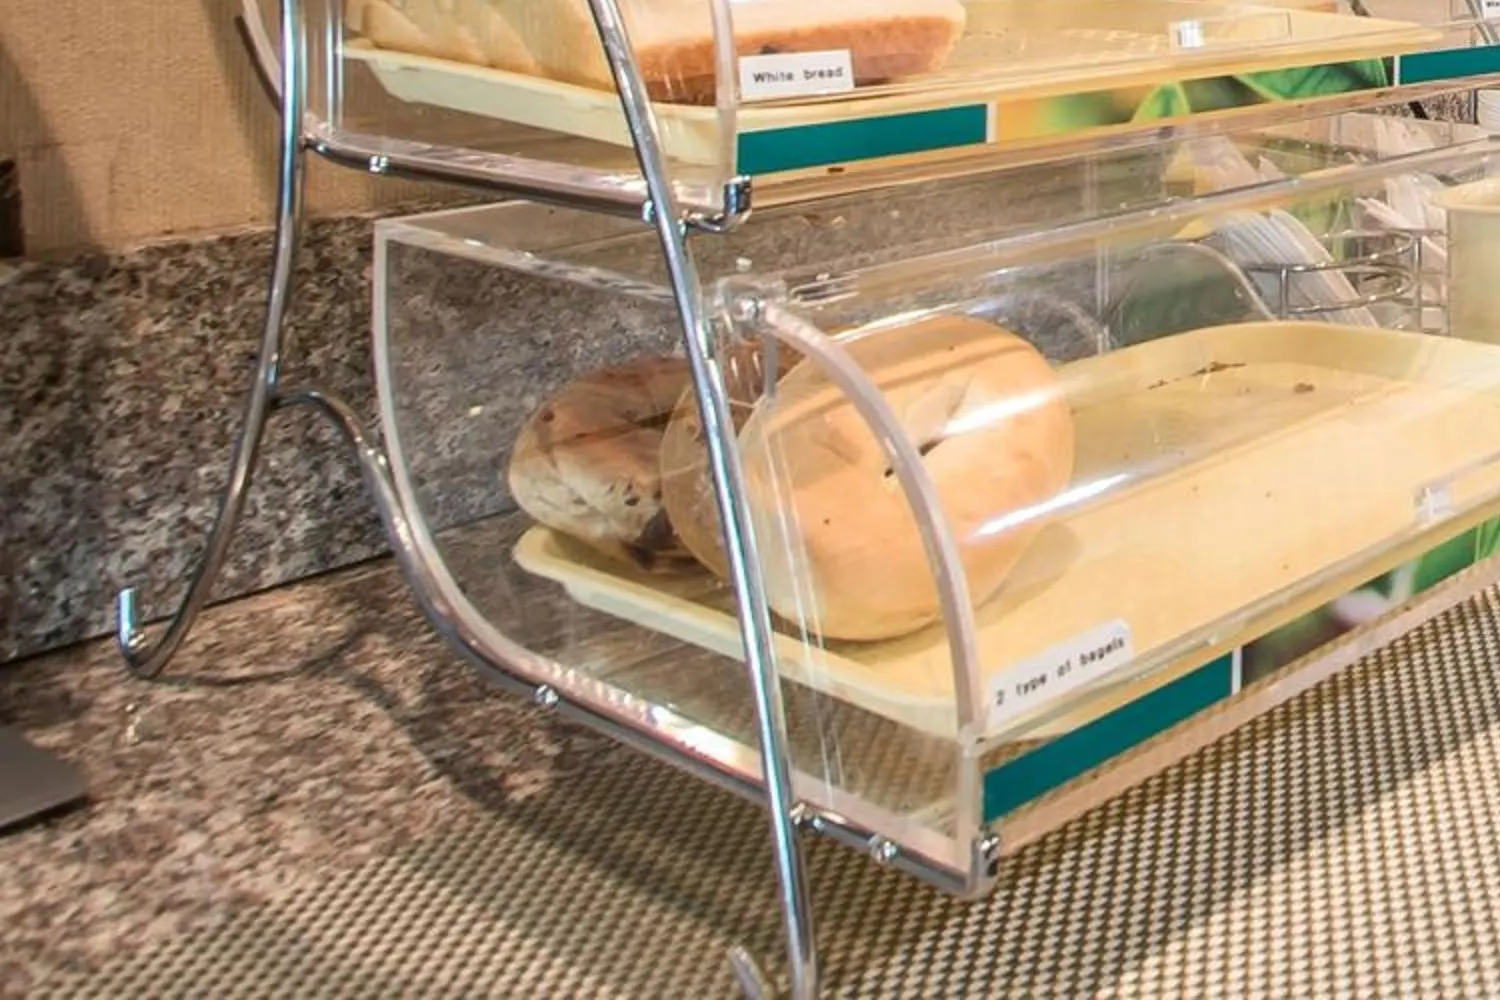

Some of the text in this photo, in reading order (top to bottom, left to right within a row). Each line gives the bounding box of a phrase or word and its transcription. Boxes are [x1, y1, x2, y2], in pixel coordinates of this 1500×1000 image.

[752, 66, 844, 83] White bread
[996, 636, 1125, 706] 2 type of bagels
